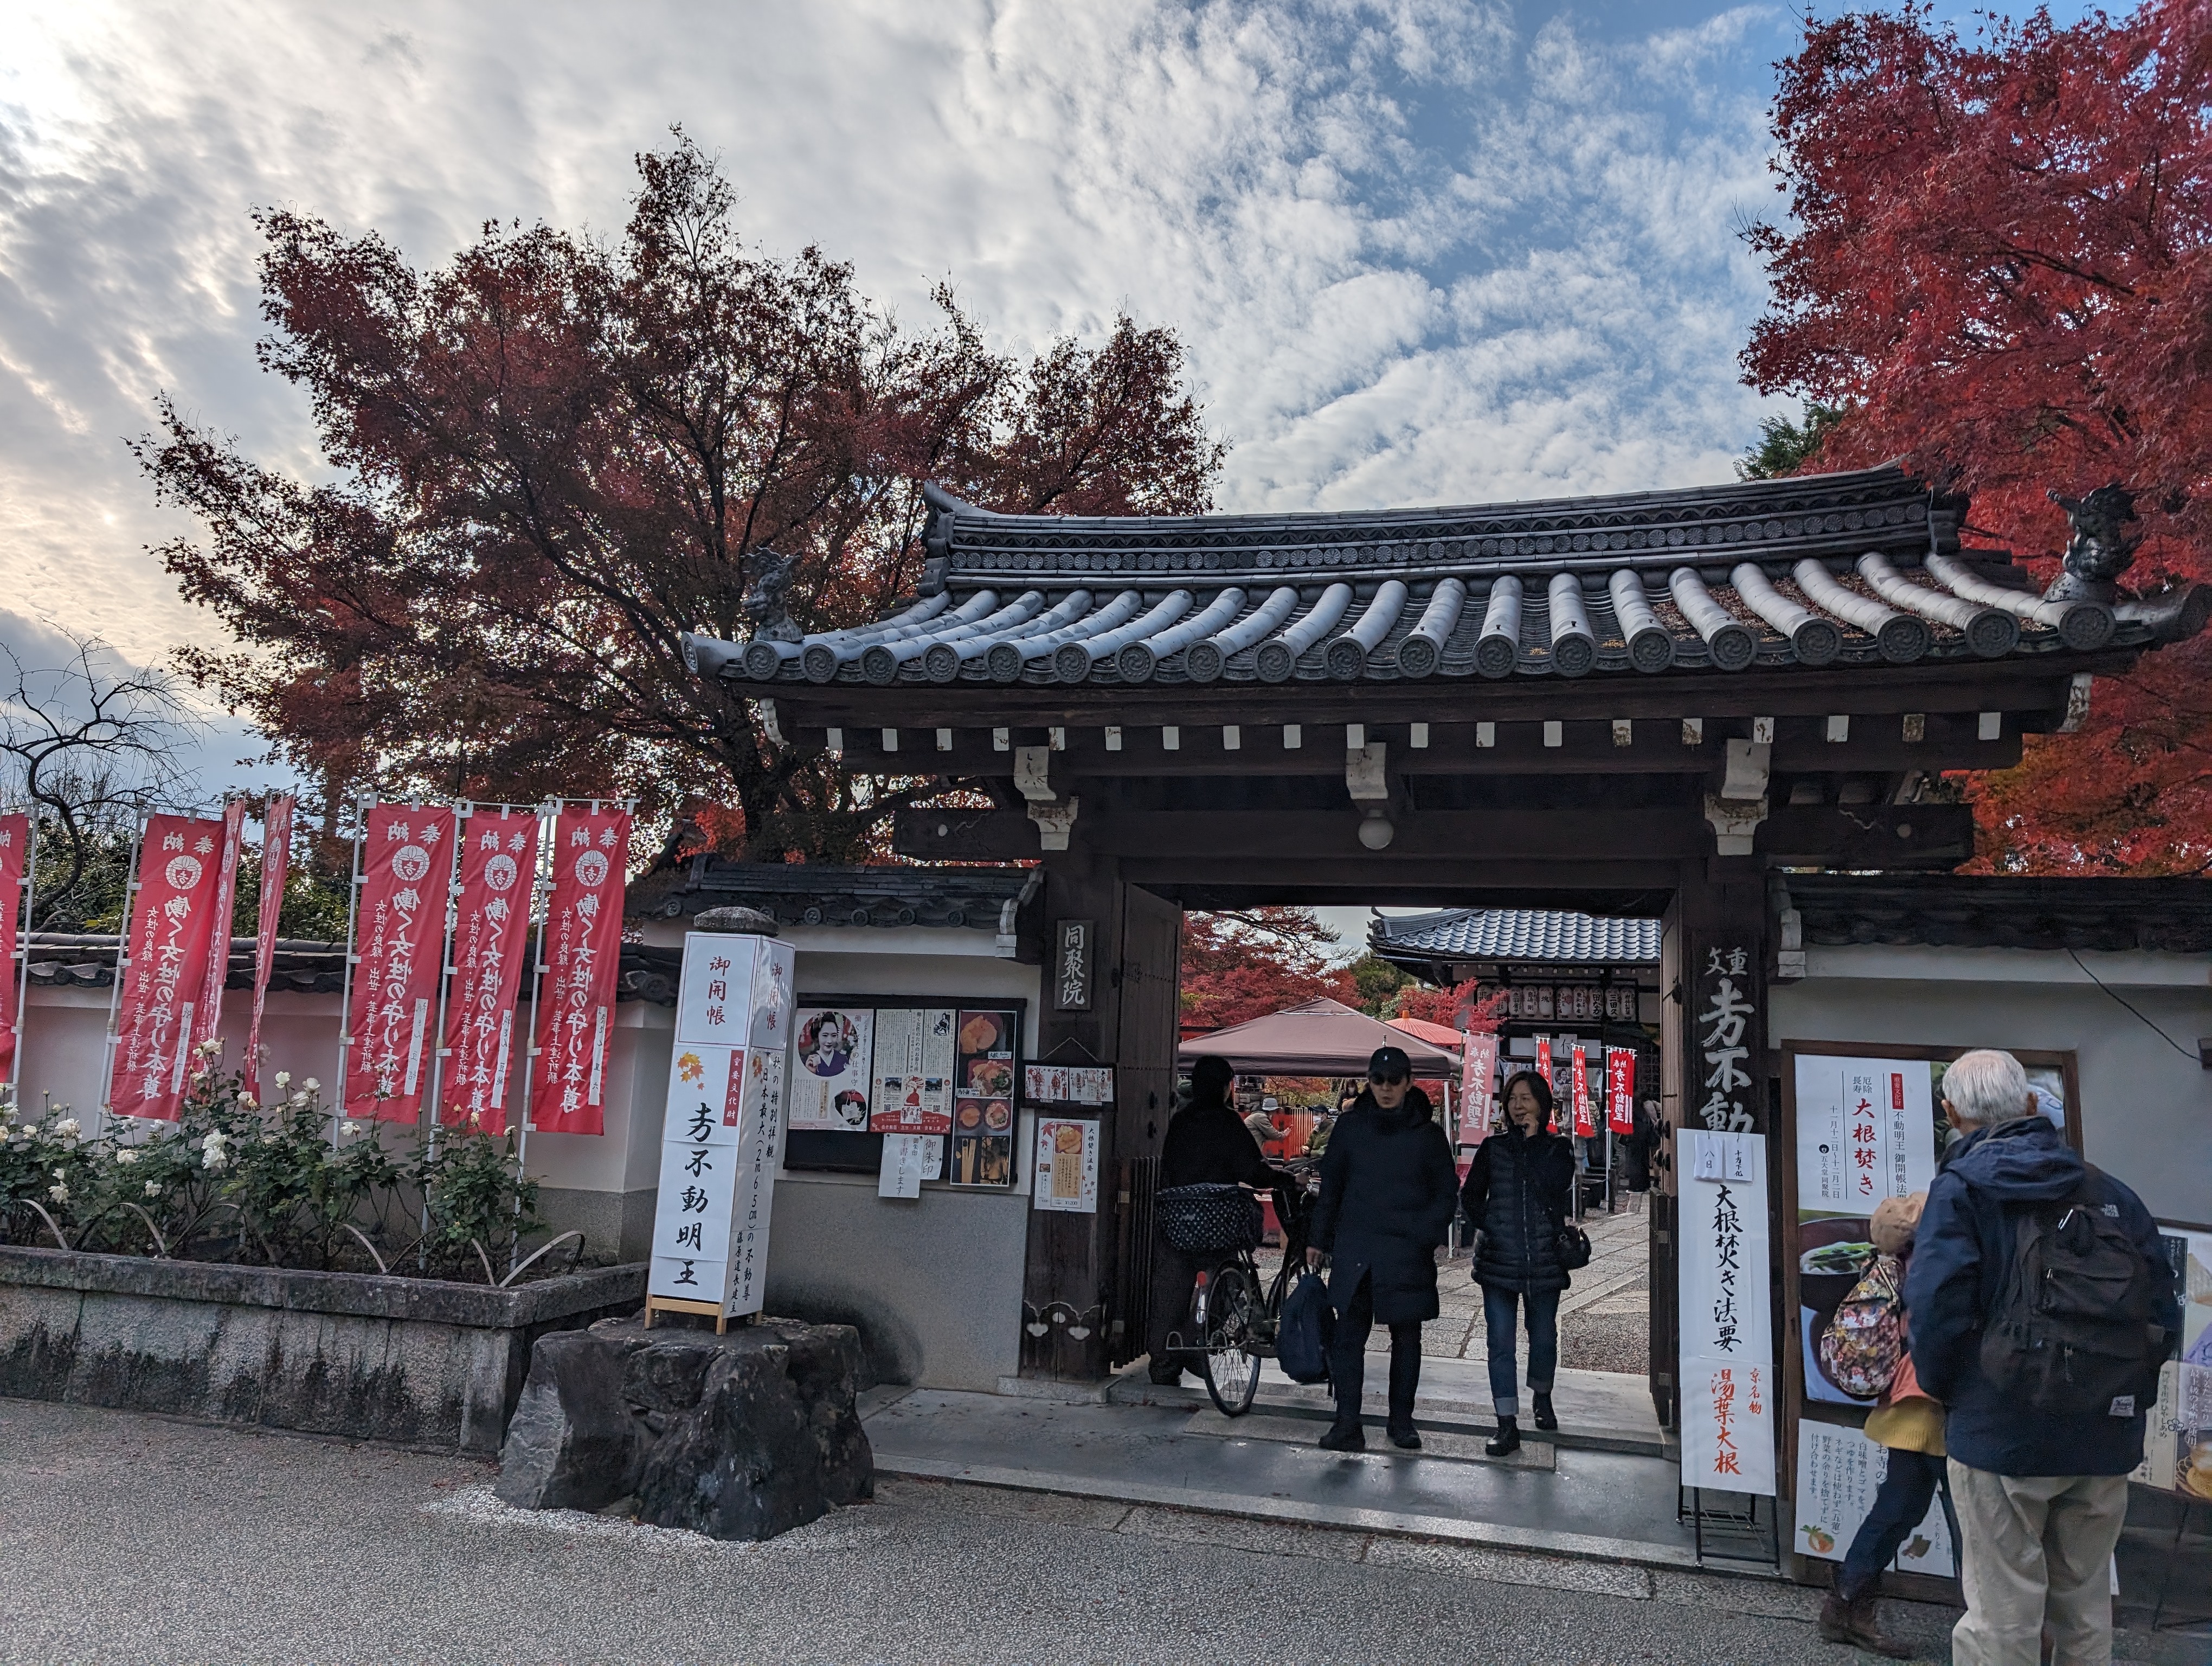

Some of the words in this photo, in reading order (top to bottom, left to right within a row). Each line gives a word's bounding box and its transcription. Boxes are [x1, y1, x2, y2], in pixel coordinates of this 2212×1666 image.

[707, 956, 731, 1026] 御開帳
[1060, 925, 1085, 1005] 同聚院
[726, 1057, 742, 1120] 重要文化財
[766, 1056, 782, 1158] 秋の特別拝観
[1853, 1076, 1862, 1093] 長寿
[1863, 1077, 1873, 1094] 厄除
[923, 1138, 936, 1176] 御朱印
[1851, 1098, 1877, 1195] 大根焚き
[1893, 1111, 1905, 1151] 不動明王
[896, 1138, 909, 1196] 手書きします
[1711, 1184, 1743, 1353] 大根焚き法要
[1711, 1369, 1742, 1475] 湯葉大根
[1748, 1368, 1762, 1415] 京名物
[1809, 1433, 1819, 1499] 付け合わせます。
[1820, 1436, 1832, 1523] 野菜の余りを捨てずに
